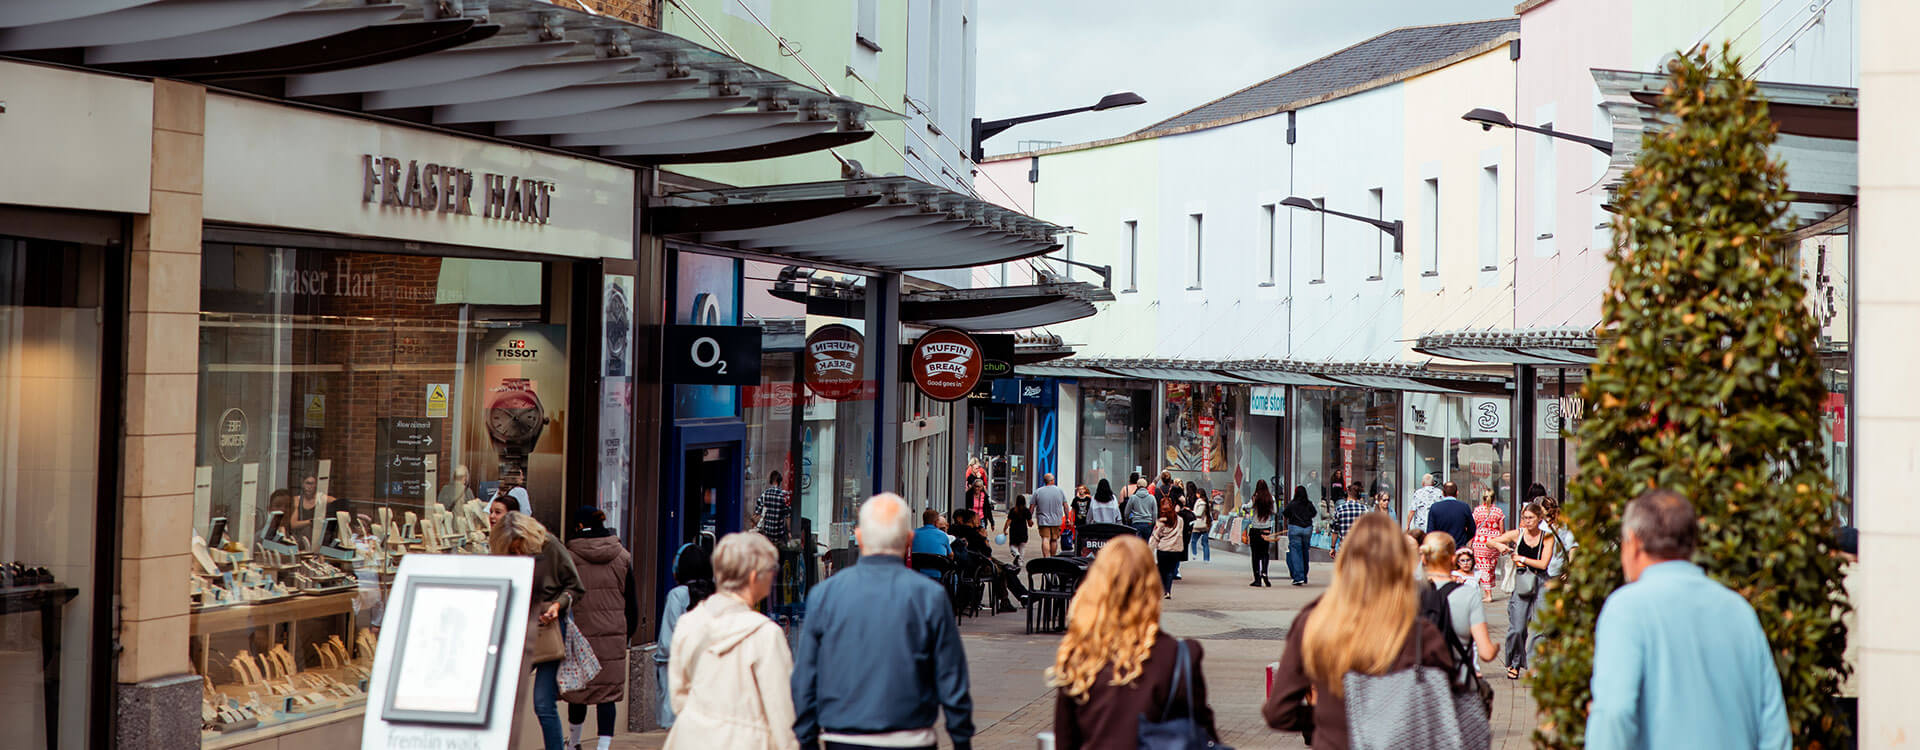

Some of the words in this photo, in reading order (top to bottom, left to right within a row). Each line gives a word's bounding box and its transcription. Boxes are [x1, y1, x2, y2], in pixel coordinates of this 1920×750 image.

[362, 154, 474, 216] FRASER
[484, 173, 555, 225] HART
[333, 256, 378, 298] Hart
[495, 349, 537, 358] TISSOT
[926, 344, 968, 355] MUFFIN
[929, 363, 962, 373] BREAK
[984, 363, 1006, 371] chuh
[1478, 402, 1499, 430] 3
[1086, 541, 1105, 549] BRU
